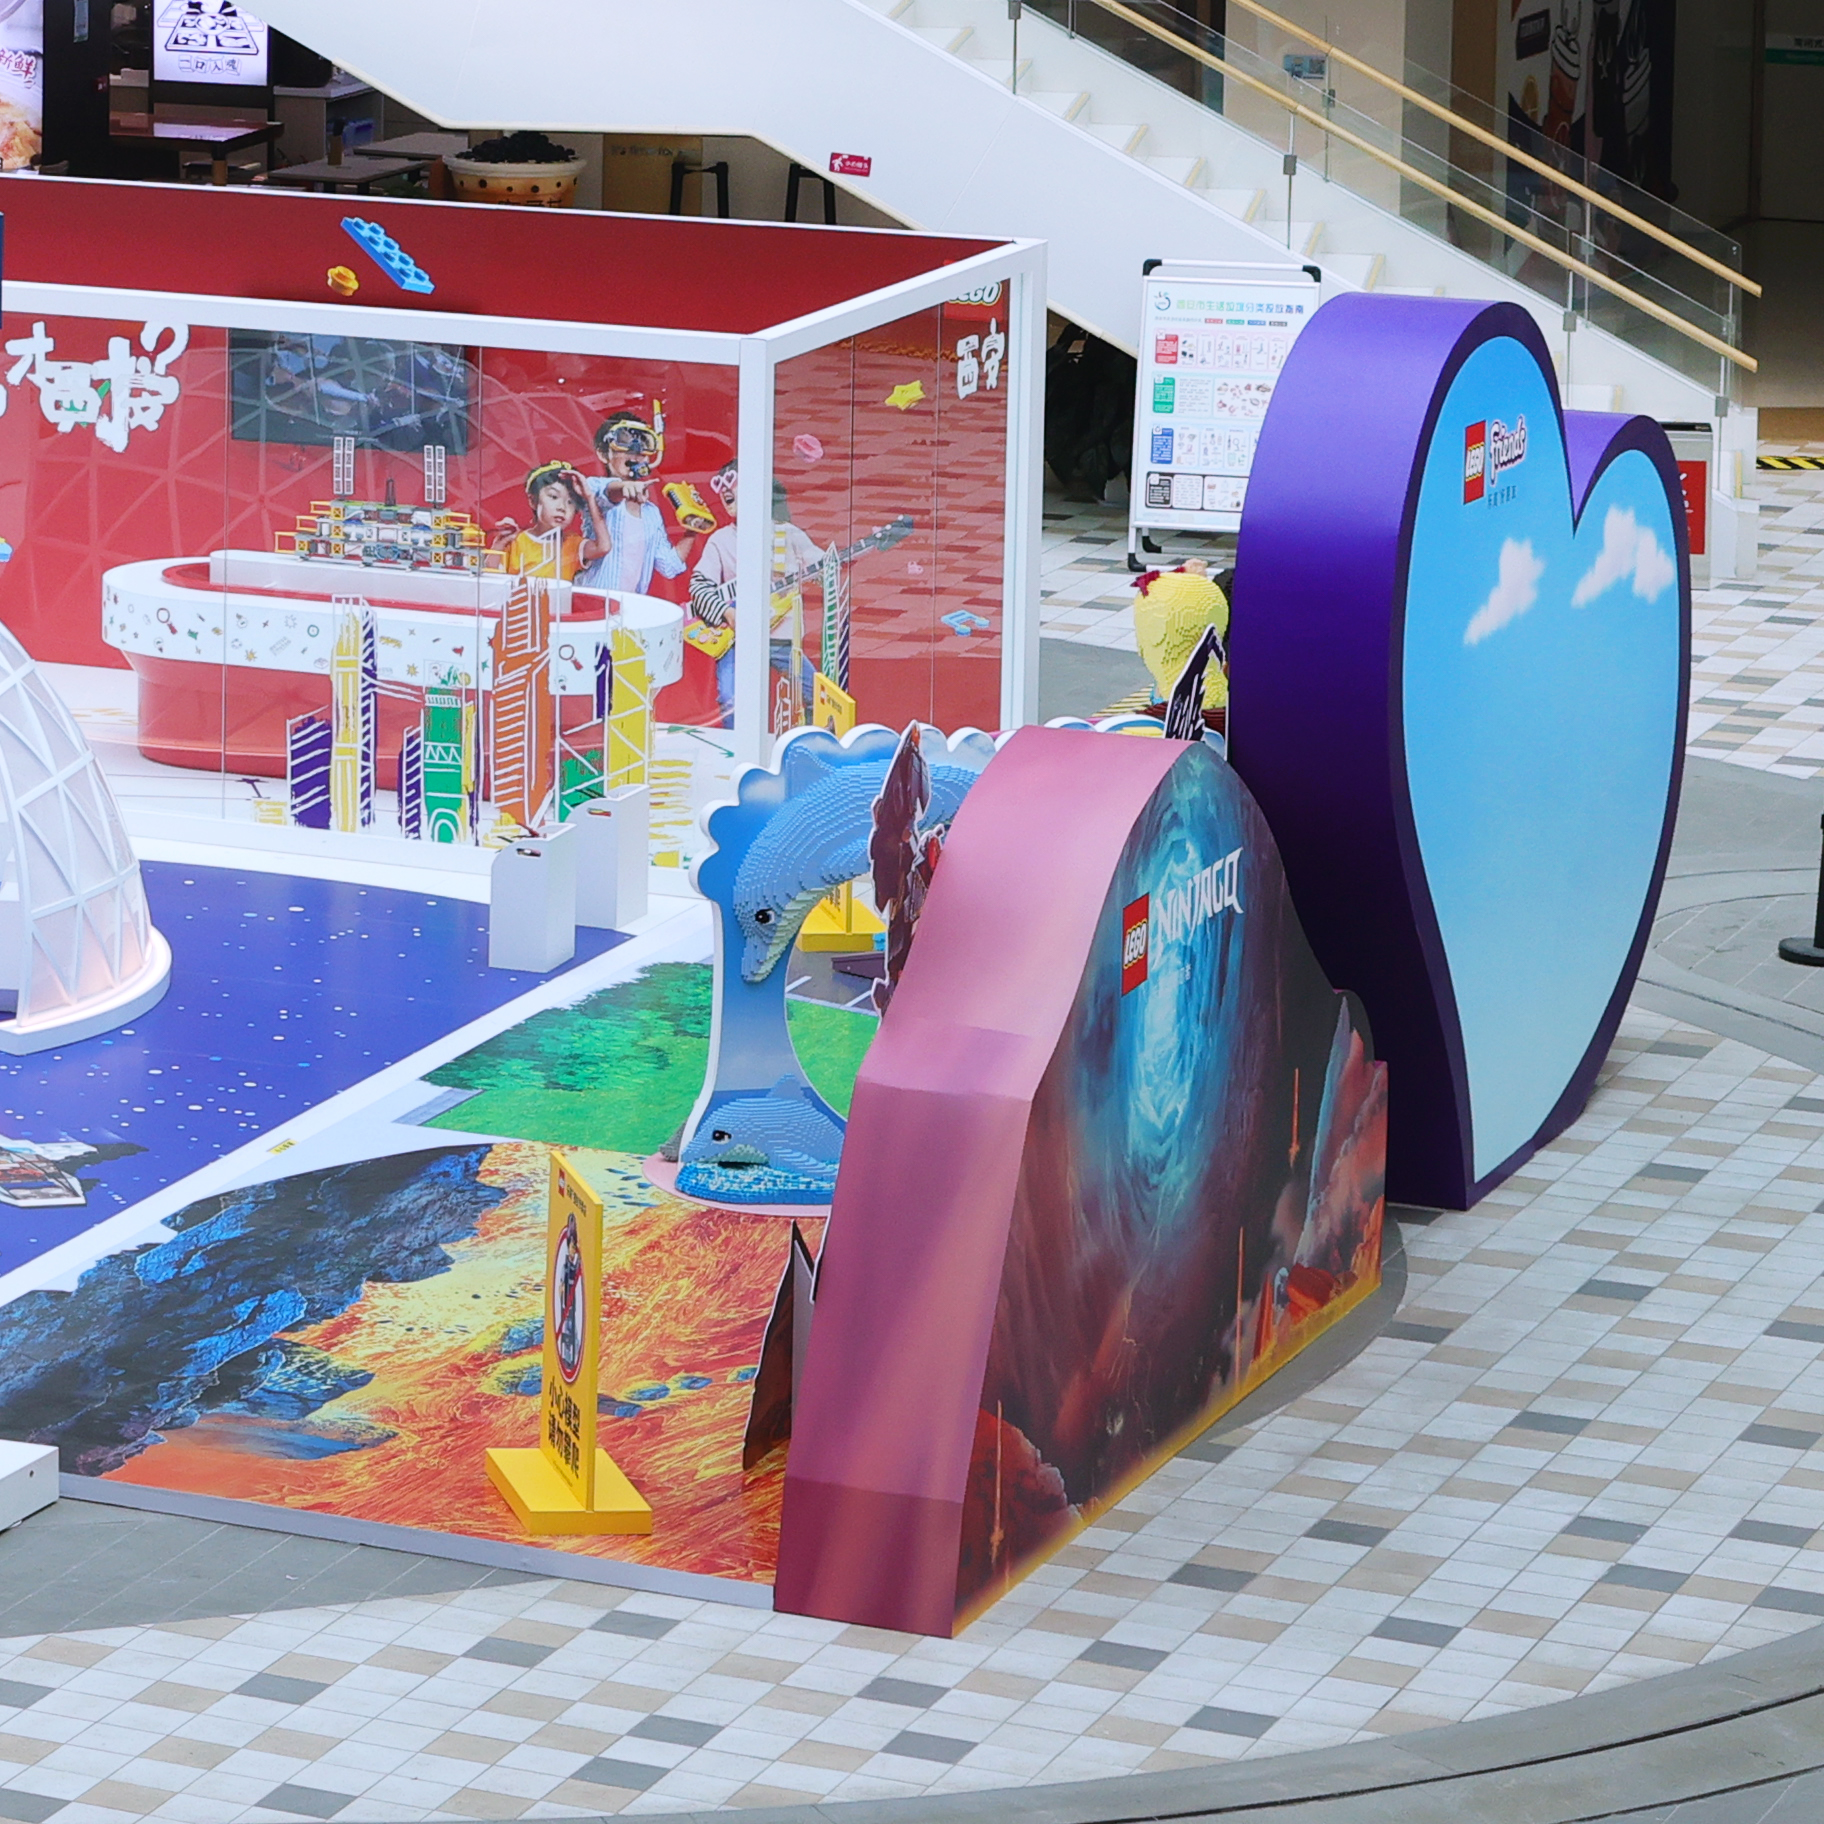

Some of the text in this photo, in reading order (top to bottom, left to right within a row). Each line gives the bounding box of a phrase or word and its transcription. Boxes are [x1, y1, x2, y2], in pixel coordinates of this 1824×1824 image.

[1464, 440, 1486, 483] LEGO
[1123, 846, 1244, 971] LEGO NINJAGO
